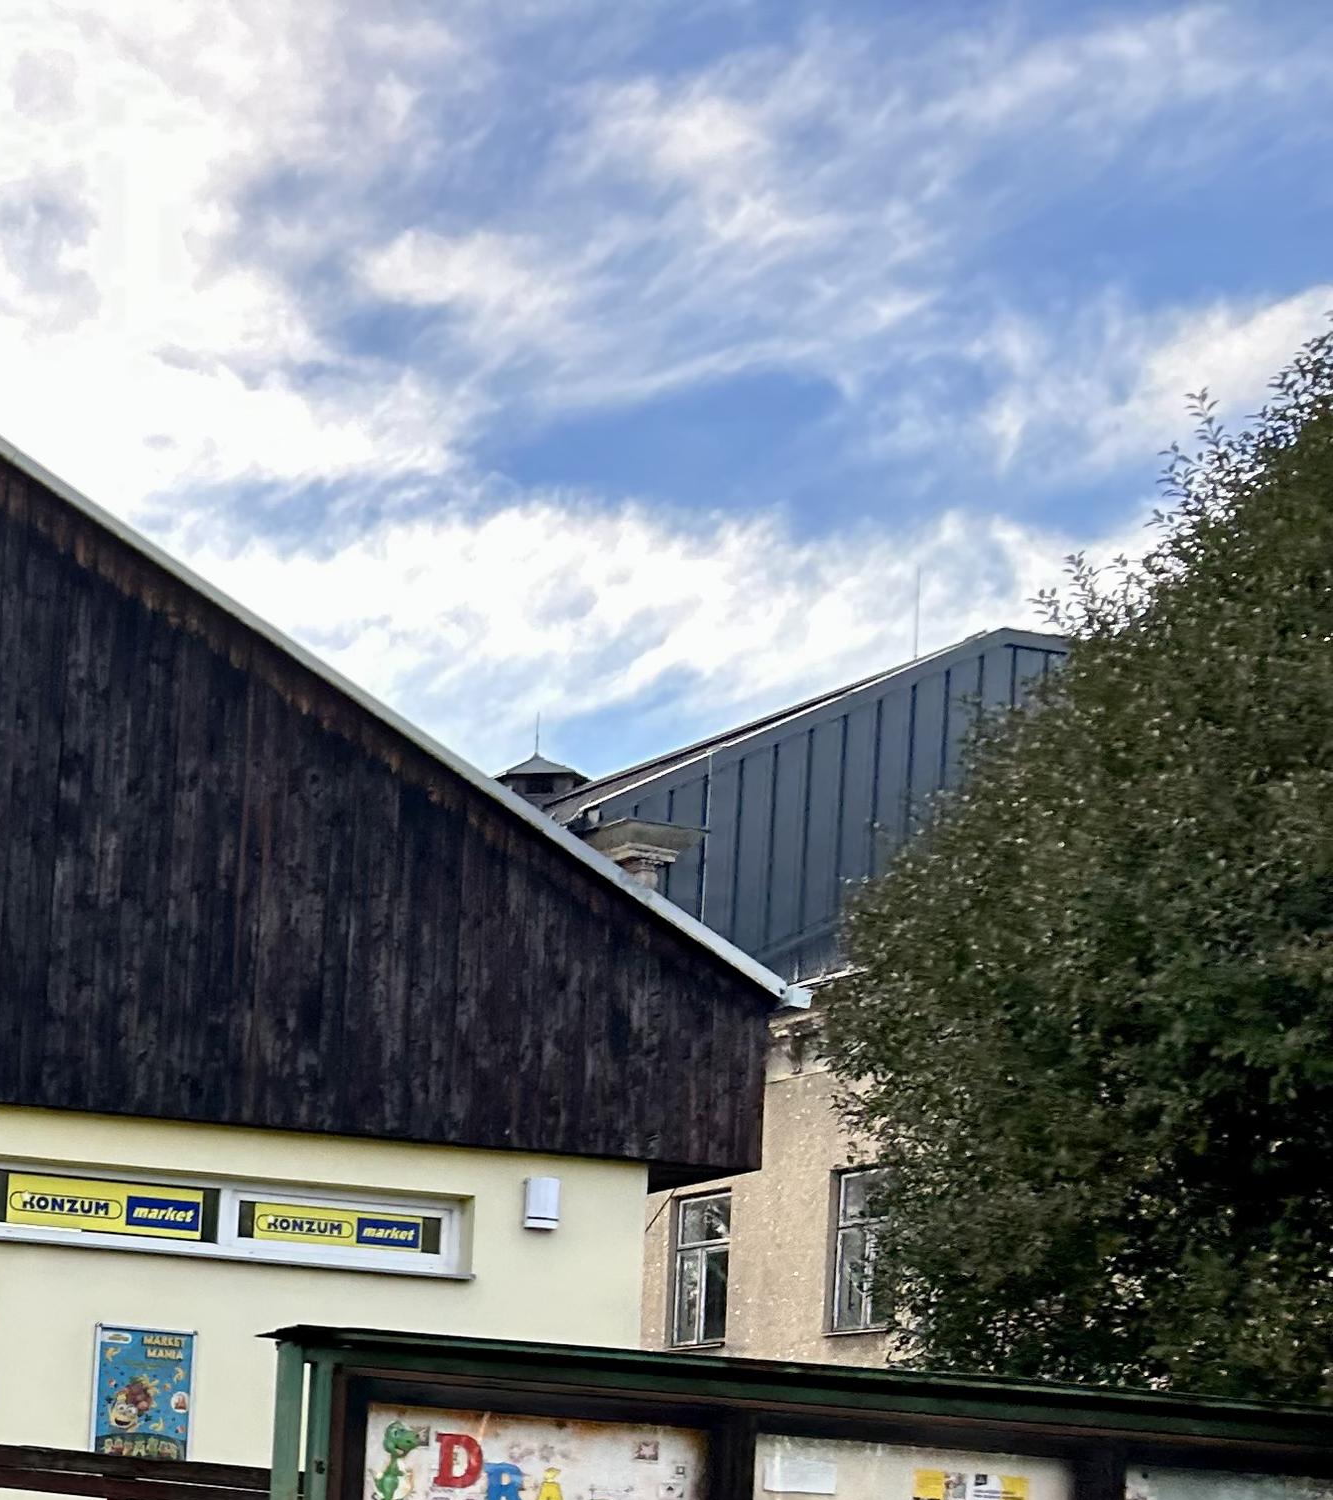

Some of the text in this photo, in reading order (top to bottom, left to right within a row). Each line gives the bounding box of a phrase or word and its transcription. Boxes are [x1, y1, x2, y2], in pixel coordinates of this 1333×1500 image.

[22, 1196, 194, 1223] KONZUM market
[267, 1217, 416, 1241] KONZUM market
[142, 1334, 186, 1348] MARKET
